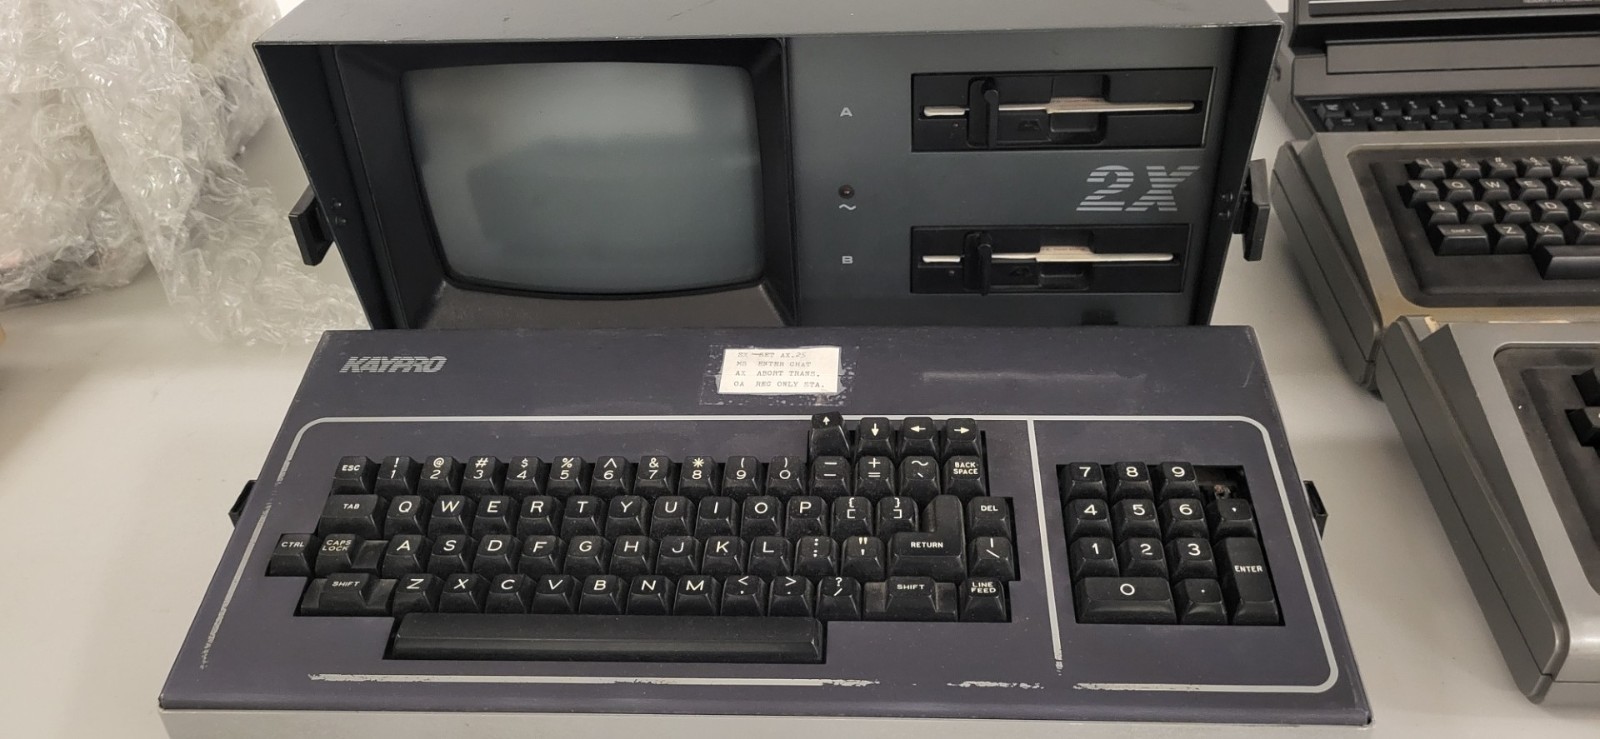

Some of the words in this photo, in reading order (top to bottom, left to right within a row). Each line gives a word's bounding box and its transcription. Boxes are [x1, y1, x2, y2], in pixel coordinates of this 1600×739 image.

[840, 107, 853, 117] A
[1076, 165, 1200, 211] 2X
[1451, 181, 1464, 189] Q
[1474, 204, 1485, 212] A
[842, 256, 853, 264] B
[339, 356, 447, 373] KAYPRO
[393, 457, 400, 468] !
[434, 458, 444, 467] @
[475, 458, 488, 467] #
[521, 458, 528, 468] $
[561, 458, 574, 468] %
[649, 458, 659, 468] &
[869, 458, 880, 468] +
[391, 470, 396, 478] 1
[430, 470, 441, 479] 2
[474, 470, 483, 479] 3
[517, 470, 526, 479] 4
[560, 470, 569, 479] 5
[604, 470, 613, 479] 6
[649, 470, 658, 479] 7
[692, 470, 702, 479] 8
[737, 470, 746, 479] 9
[780, 470, 790, 479] 0
[1080, 467, 1090, 477] 7
[1126, 467, 1138, 477] 8
[1172, 467, 1185, 477] 9
[399, 501, 412, 512] Q
[442, 501, 459, 512] W
[487, 501, 501, 512] E
[530, 501, 544, 512] R
[578, 501, 588, 513] T
[621, 501, 633, 512] Y
[665, 502, 677, 513] U
[714, 502, 718, 513] I
[755, 502, 768, 513] O
[800, 502, 811, 513] P
[848, 497, 855, 509] {
[894, 497, 901, 509] }
[847, 509, 855, 518] [
[894, 507, 902, 518] ]
[1084, 505, 1097, 515] 4
[1133, 504, 1145, 515] 5
[1179, 504, 1192, 515] 6
[397, 540, 410, 550] A
[444, 540, 456, 551] S
[488, 540, 502, 551] D
[533, 542, 547, 552] F
[579, 541, 592, 551] G
[624, 541, 639, 552] H
[672, 542, 684, 553] J
[716, 541, 729, 552] K
[763, 542, 774, 552] L
[1092, 543, 1099, 554] 1
[1141, 544, 1152, 555] 2
[1188, 543, 1200, 555] 3
[407, 579, 424, 589] Z
[454, 579, 468, 589] X
[501, 579, 515, 589] C
[549, 580, 563, 589] V
[594, 580, 606, 590] B
[642, 580, 656, 590] N
[686, 580, 704, 590] M
[738, 576, 748, 585] <
[786, 577, 796, 586] >
[834, 588, 842, 596] /
[1120, 584, 1135, 595] 0
